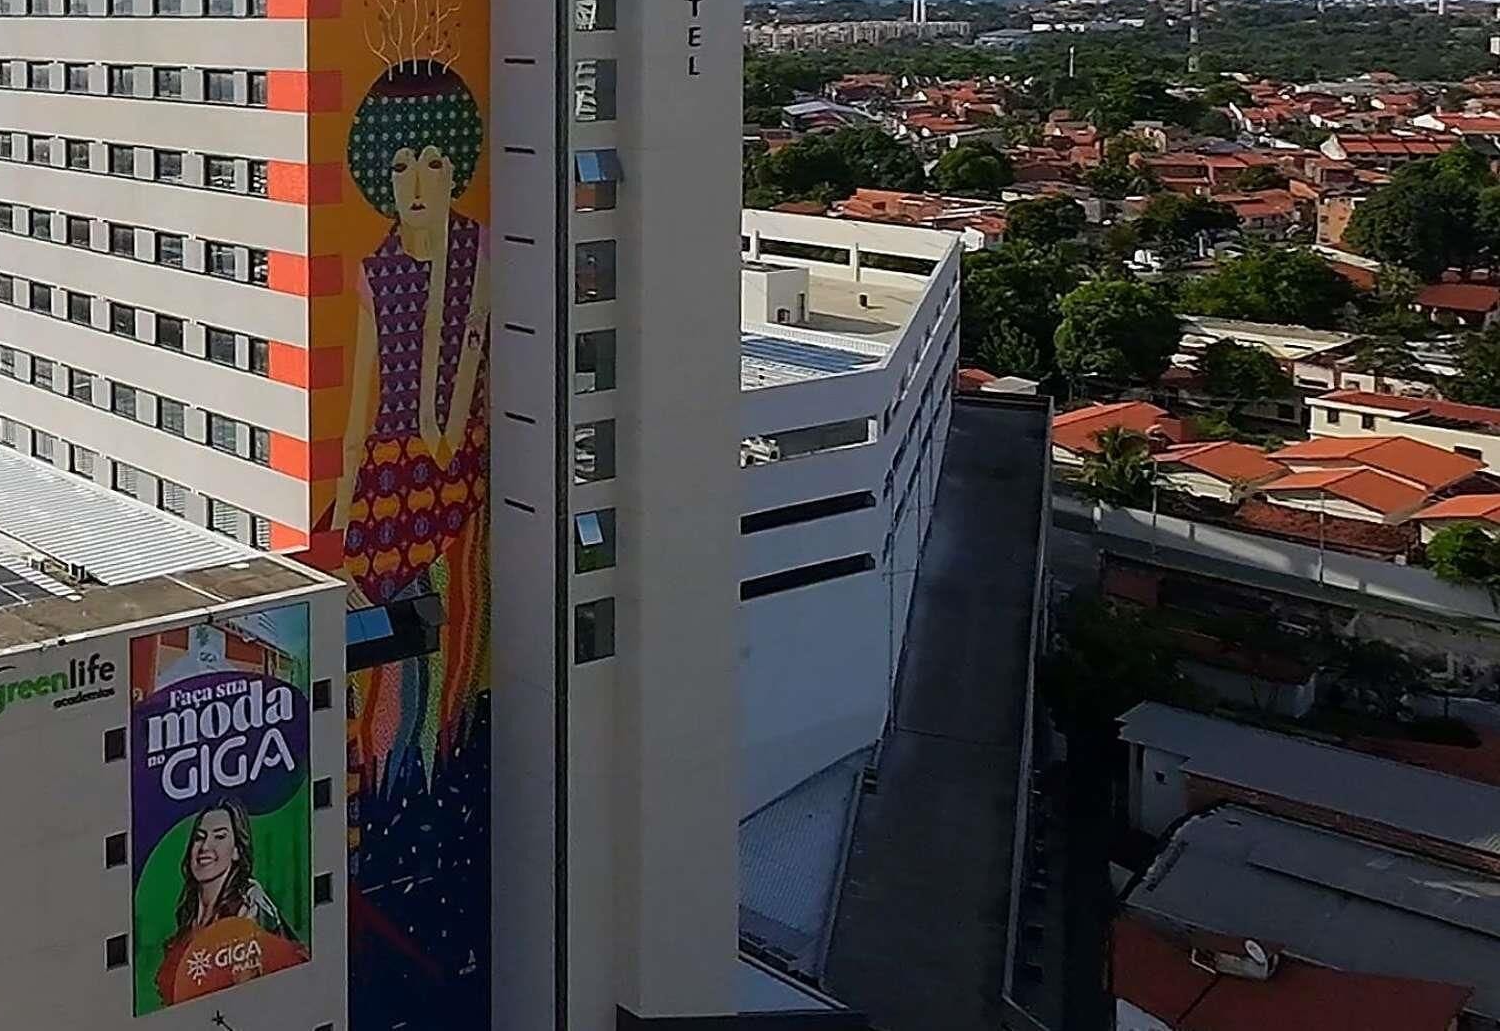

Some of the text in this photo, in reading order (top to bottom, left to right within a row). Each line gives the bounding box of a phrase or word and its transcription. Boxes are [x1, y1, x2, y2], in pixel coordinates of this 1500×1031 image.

[147, 680, 294, 754] moda
[169, 679, 248, 709] Faça sua
[147, 727, 295, 800] no GIGA
[215, 939, 262, 967] GIGA
